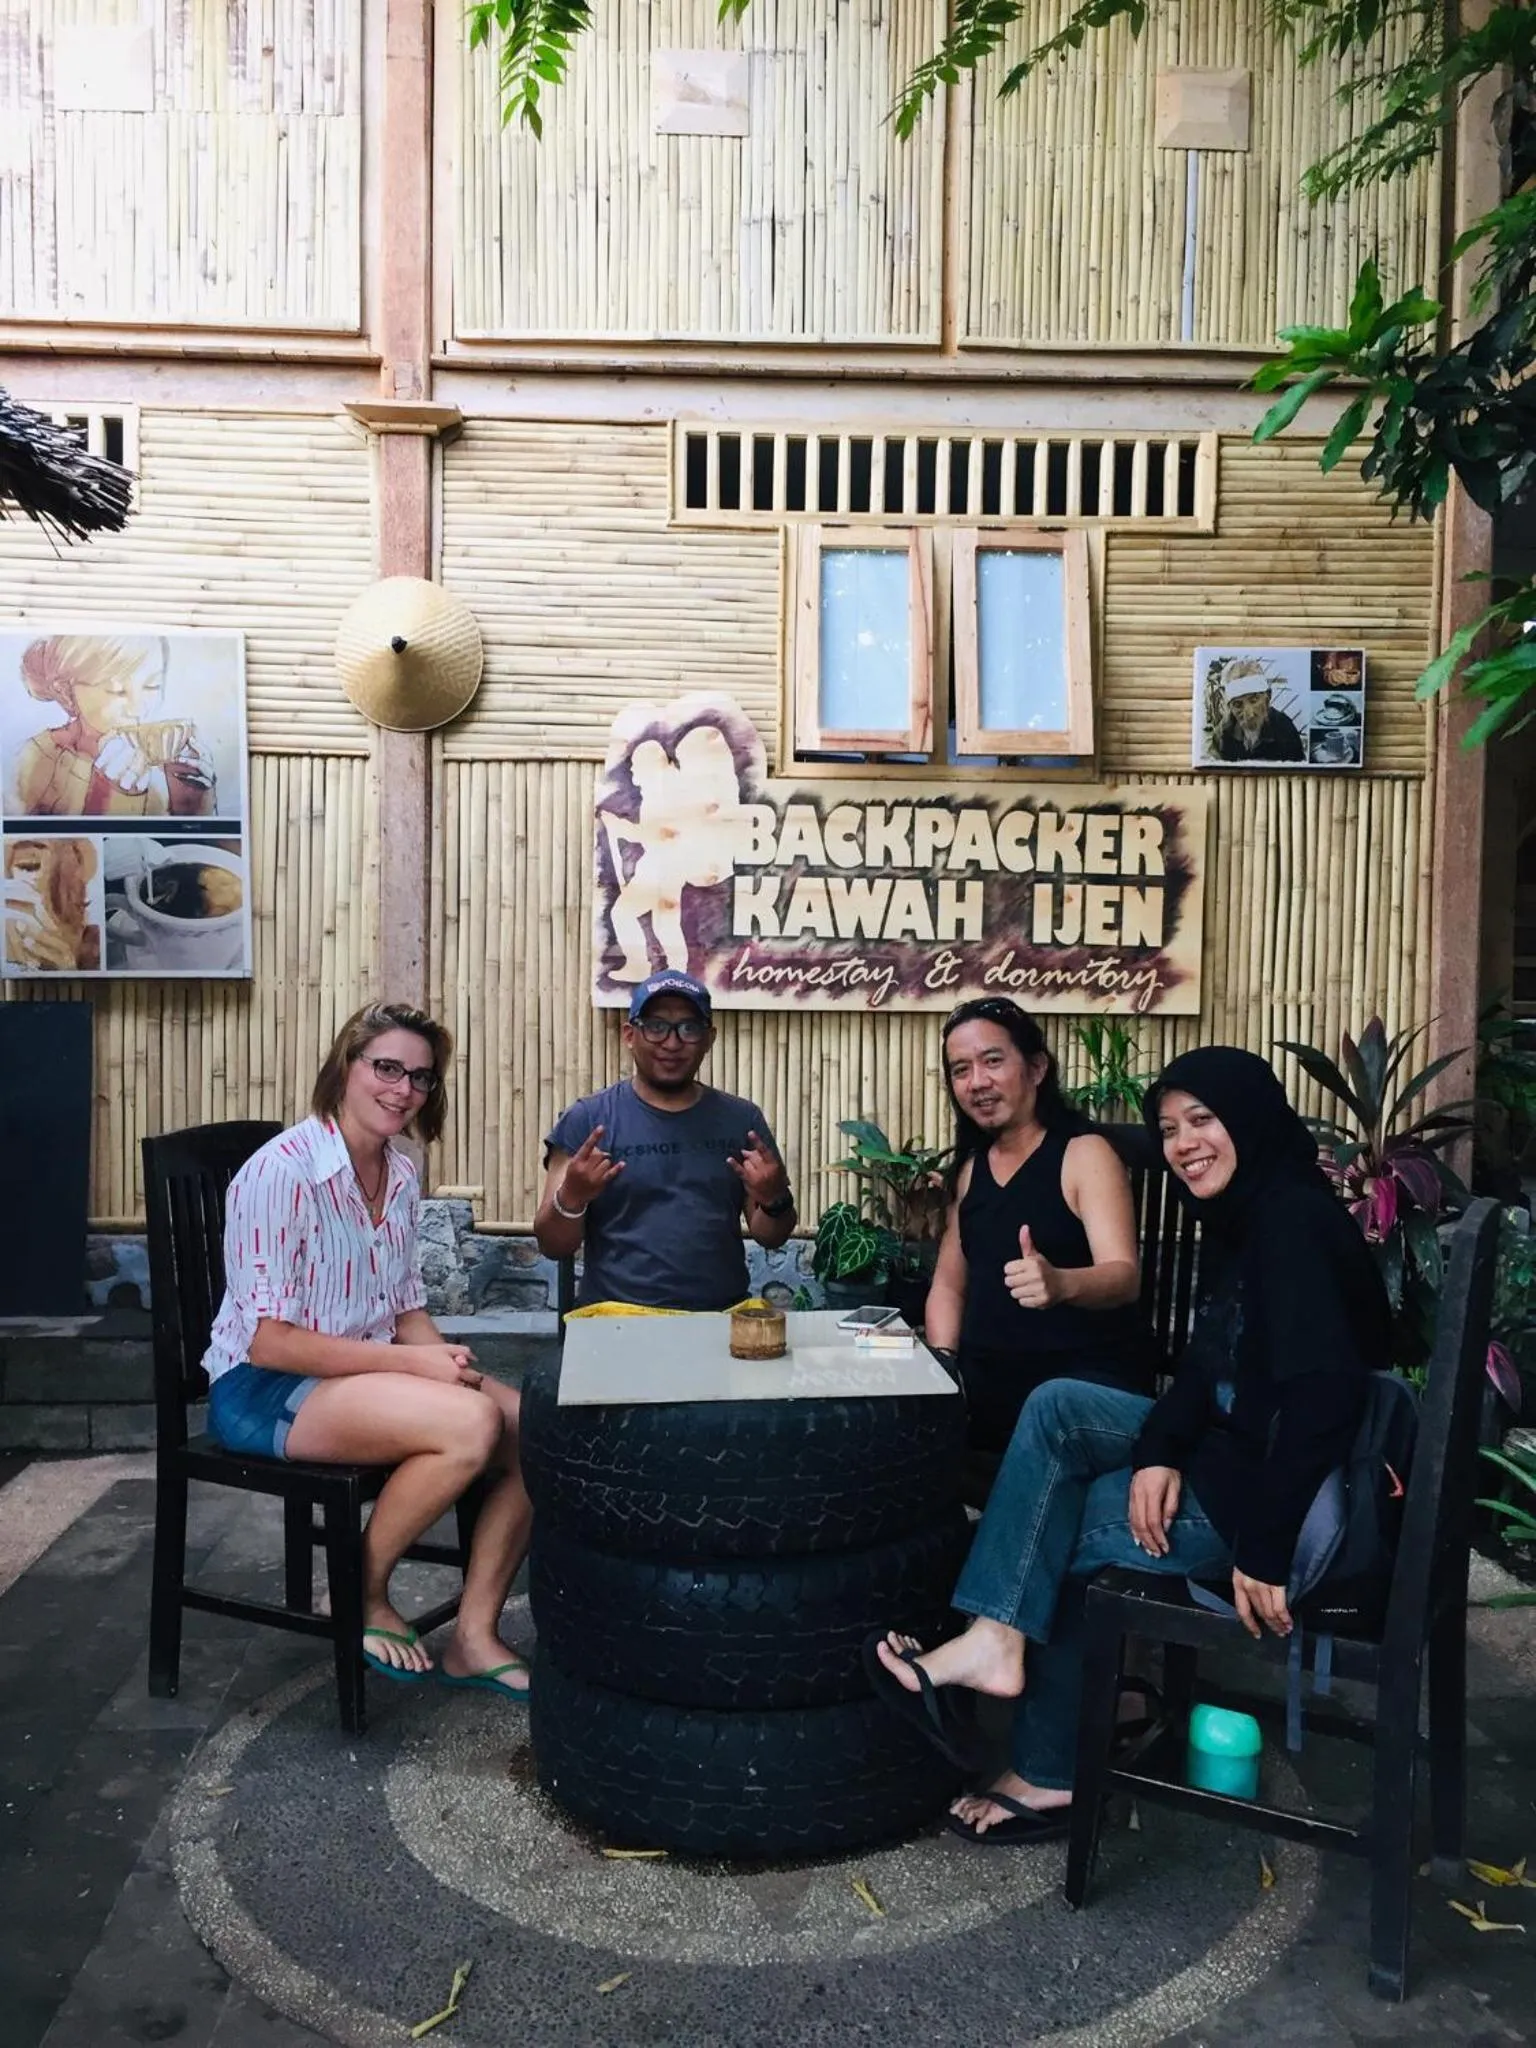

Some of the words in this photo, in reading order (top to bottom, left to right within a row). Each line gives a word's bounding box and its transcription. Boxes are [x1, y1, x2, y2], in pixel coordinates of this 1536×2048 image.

[734, 803, 1165, 876] BACKPACKER
[732, 875, 984, 942] KAWAH
[1032, 884, 1163, 948] IJEN
[732, 947, 900, 1006] homestay
[924, 950, 958, 988] &
[984, 950, 1164, 1011] dormitory
